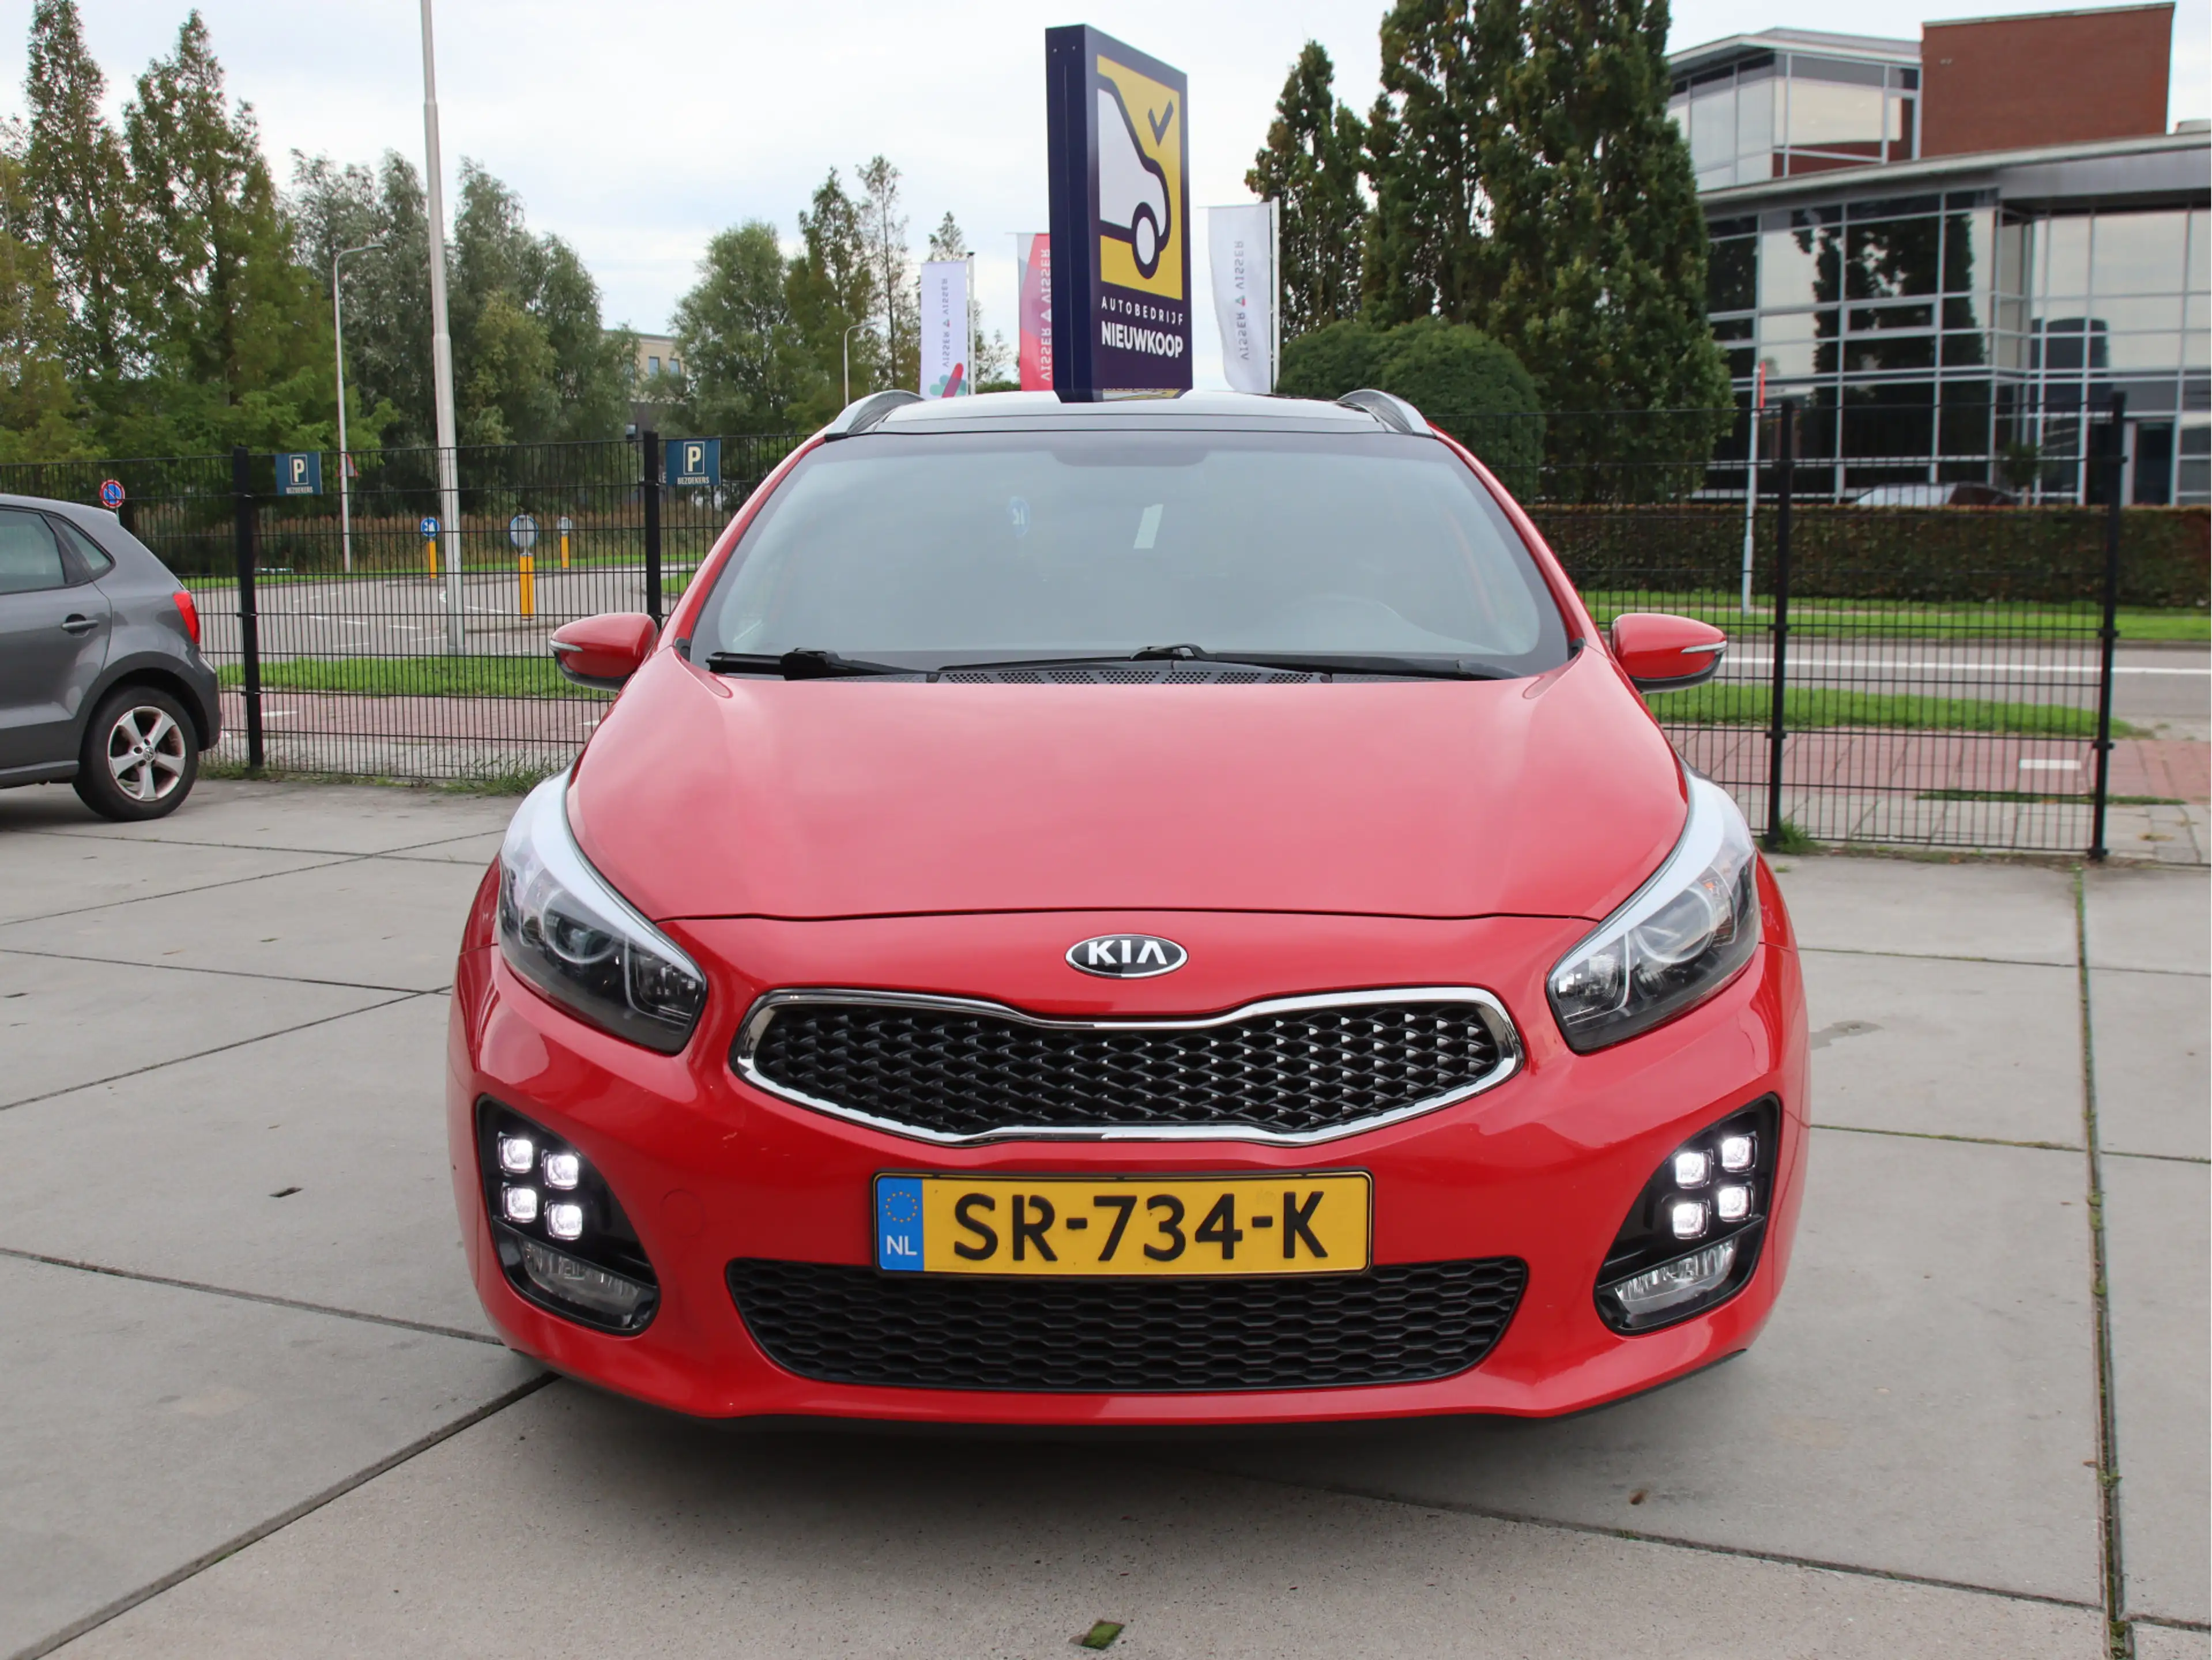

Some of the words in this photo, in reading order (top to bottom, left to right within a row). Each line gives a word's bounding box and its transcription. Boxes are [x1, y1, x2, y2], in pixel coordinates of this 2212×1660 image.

[1101, 296, 1184, 326] AUTOBEDRIJF
[1101, 320, 1184, 358] NIEUWKOOP
[293, 458, 305, 482] P
[688, 446, 702, 472] P
[1087, 940, 1168, 965] KIA
[954, 1190, 1329, 1262] SR-734-K
[886, 1235, 918, 1255] NL
